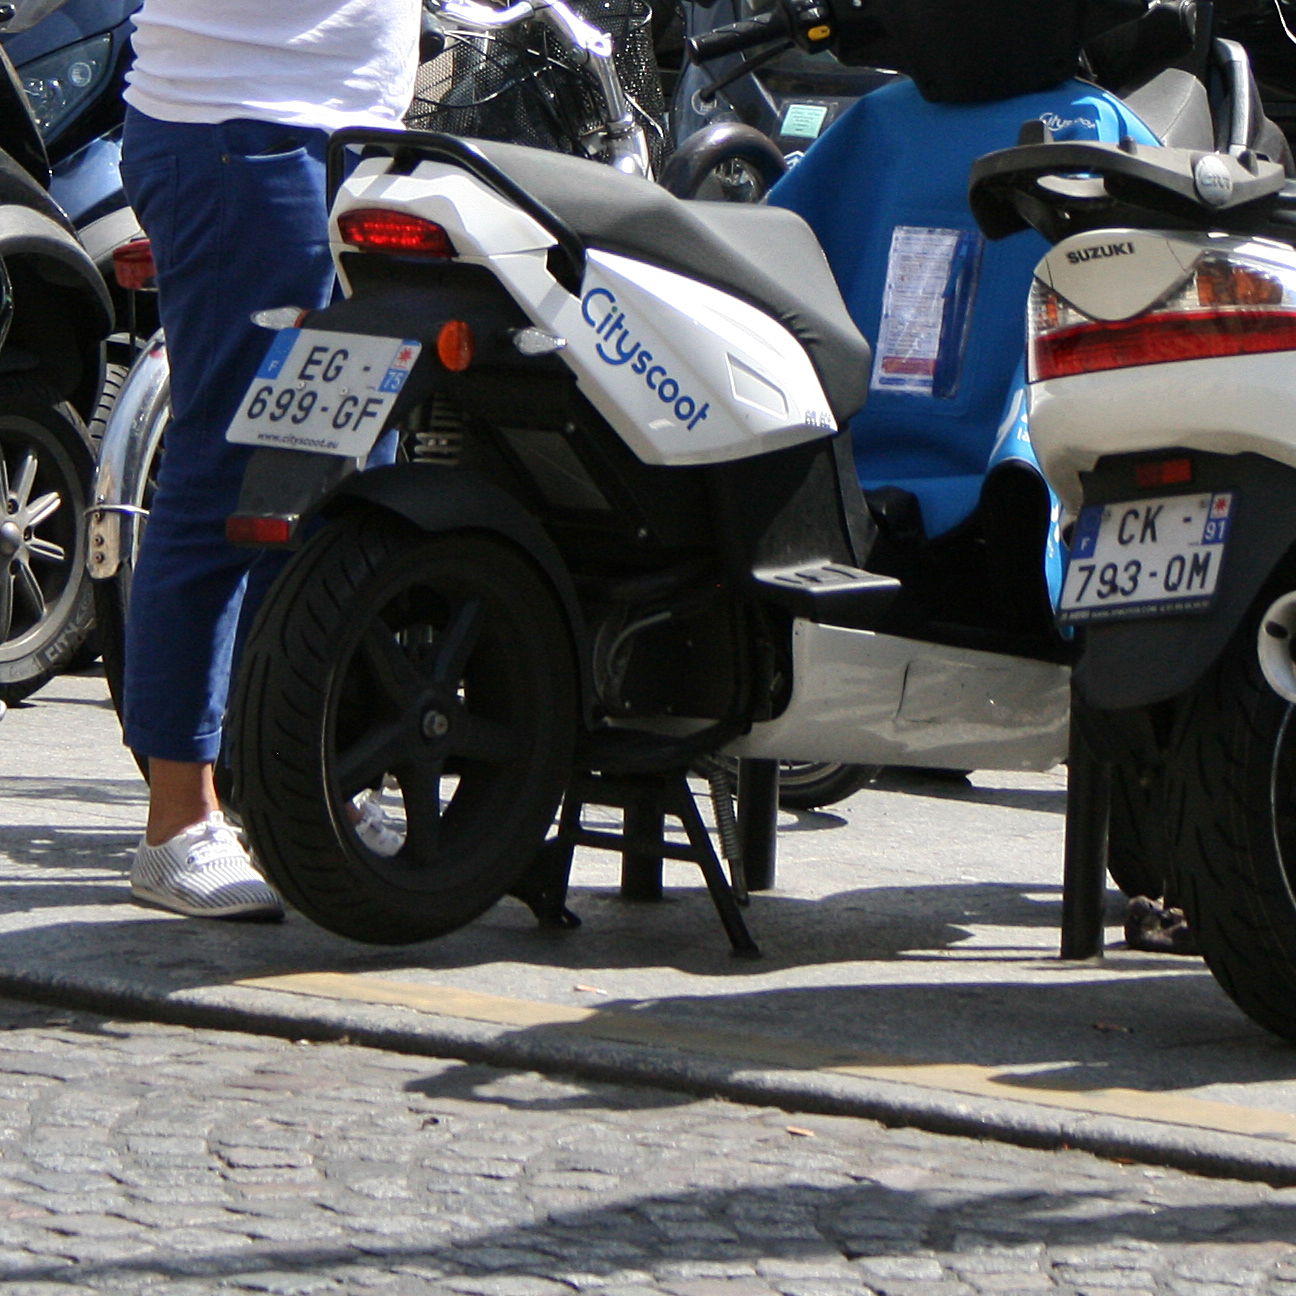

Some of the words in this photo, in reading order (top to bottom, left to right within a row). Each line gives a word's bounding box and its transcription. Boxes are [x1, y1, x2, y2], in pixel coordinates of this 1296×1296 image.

[1067, 241, 1135, 265] SUZUKI
[298, 345, 349, 382] EG
[581, 287, 711, 432] Cityscoot
[382, 371, 402, 391] 75
[247, 385, 385, 432] 699-GF
[1117, 505, 1164, 546] CK
[1204, 520, 1226, 541] 91
[1075, 550, 1213, 603] 793-QM
